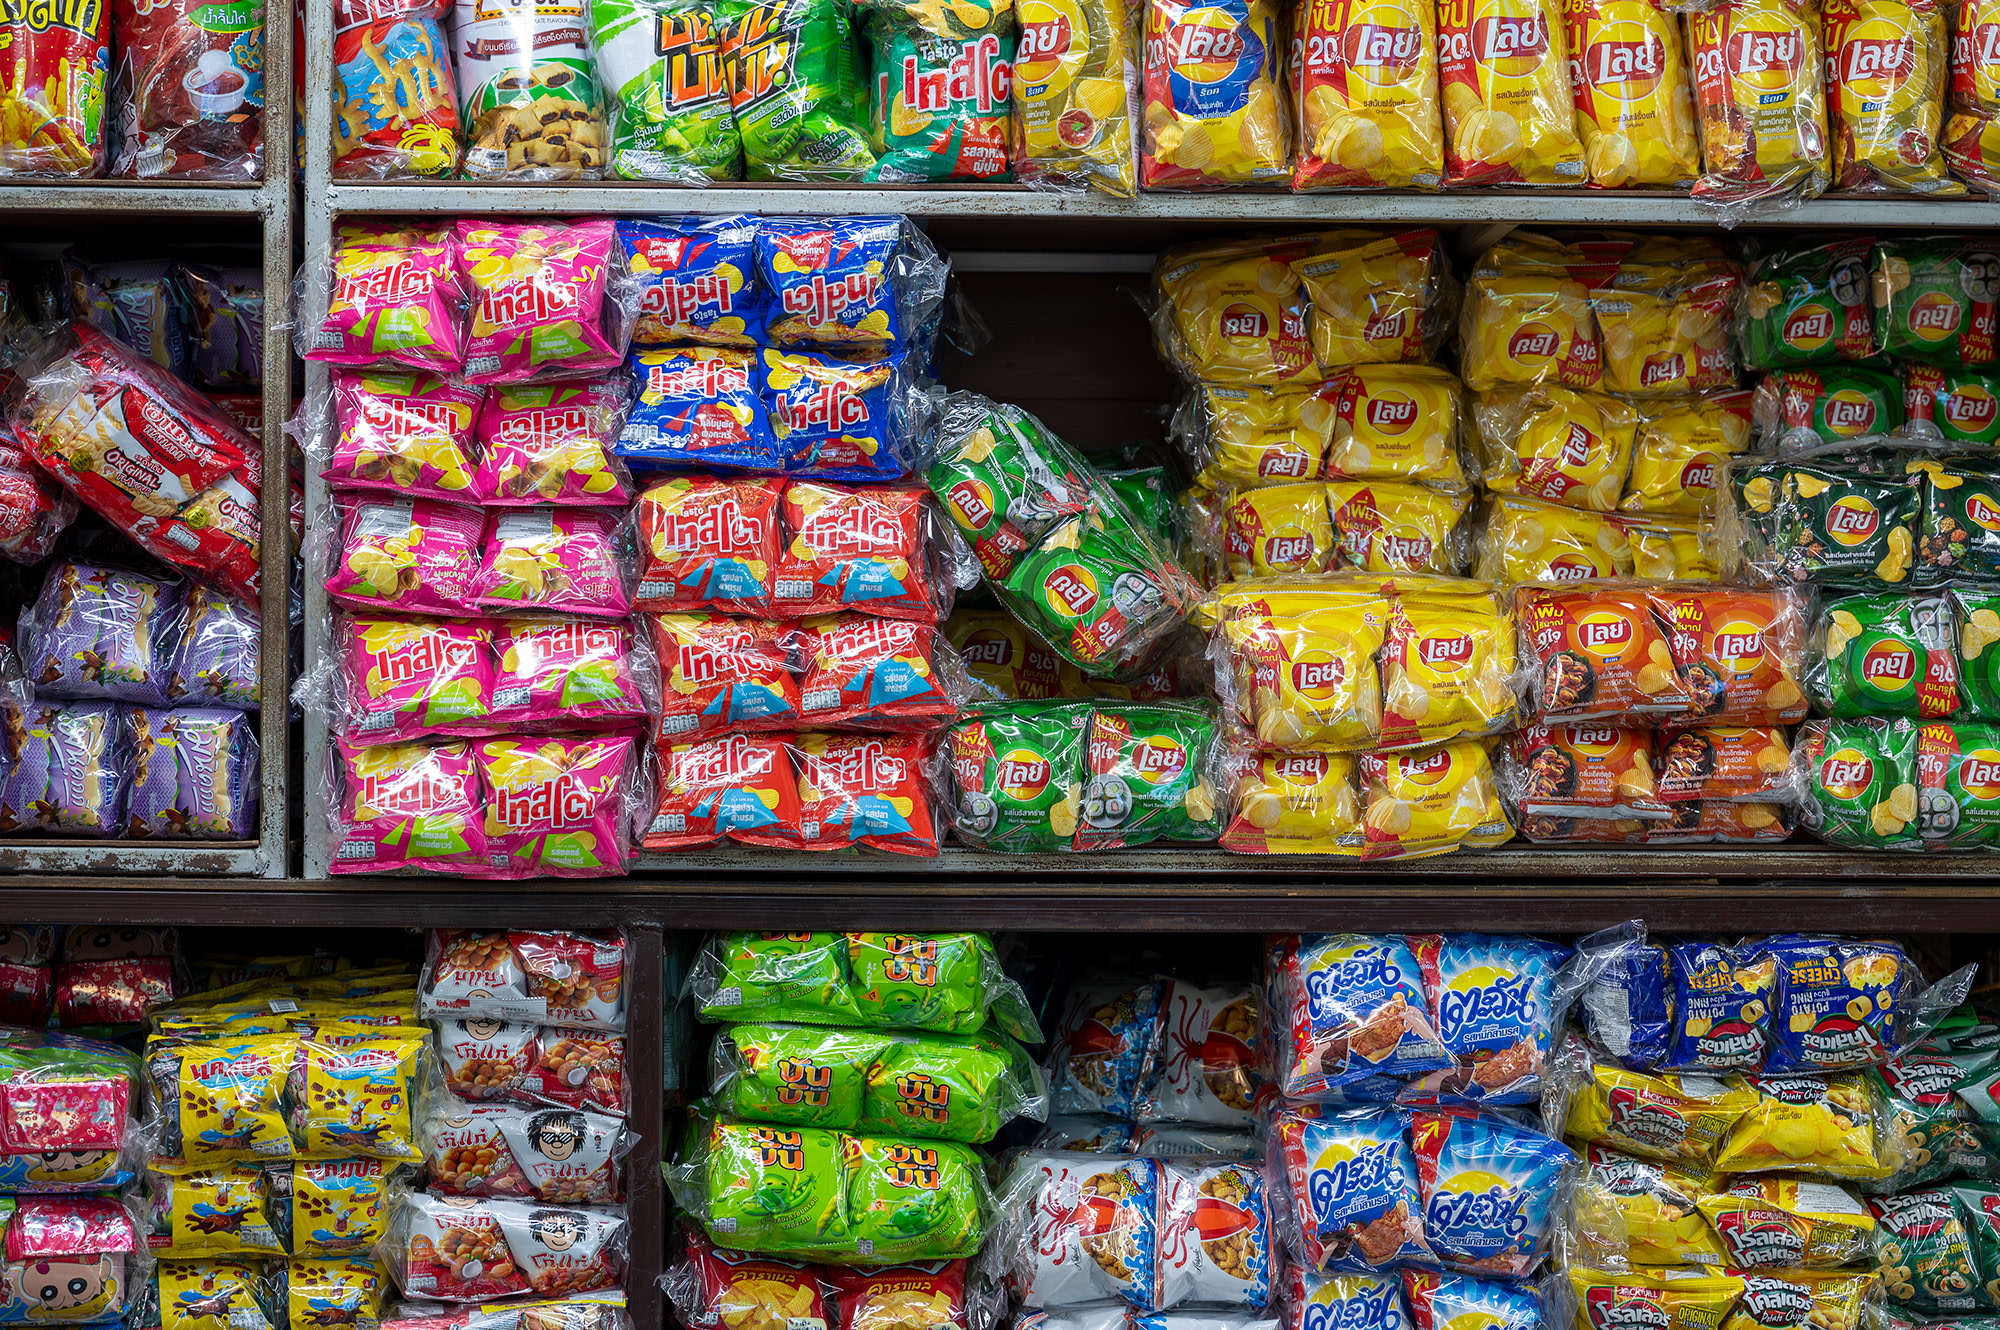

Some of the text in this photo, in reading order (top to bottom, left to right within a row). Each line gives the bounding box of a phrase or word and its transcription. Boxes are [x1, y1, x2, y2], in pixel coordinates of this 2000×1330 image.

[203, 10, 247, 26] น้ำจิ้มไก่
[920, 43, 956, 61] Tasto
[1308, 34, 1341, 67] 20%
[1353, 24, 1419, 68] เลย์
[1440, 33, 1471, 65] 20%
[1486, 17, 1544, 66] เลย์
[1739, 26, 1799, 75] เลย์
[1596, 36, 1658, 85] เลย์
[1848, 35, 1908, 81] เลย์
[1310, 66, 1336, 76] ราคาเดิม
[1364, 97, 1408, 111] รสมันฝรั่งแท้
[1497, 86, 1541, 103] รสมันฝรั่งแท้
[973, 156, 999, 174] ญี่ปุ่น
[337, 258, 433, 304] เทสโต
[483, 266, 578, 326] เทสโต
[642, 277, 732, 328] เทสโต
[783, 274, 882, 328] เทสโต
[842, 307, 868, 320] Tasto
[1914, 305, 1954, 328] เลย์
[1226, 315, 1260, 338] เลย์
[1790, 316, 1829, 341] เลย์
[1516, 334, 1554, 357] เลย์
[649, 358, 750, 398] เทสโต
[665, 360, 691, 371] Tasto
[1646, 358, 1679, 384] เลย์
[776, 382, 870, 434] เทสโต
[1374, 400, 1414, 422] เลย์
[104, 446, 162, 492] ORIGINAL
[1265, 453, 1301, 477] เลย์
[116, 471, 150, 498] FLAVOUR
[679, 507, 705, 518] Tasto
[1832, 507, 1873, 534] เลย์
[666, 501, 763, 553] เทสโต
[804, 503, 902, 553] เทสโต
[1273, 538, 1312, 563] เลย์
[1391, 539, 1428, 558] เลย์
[1675, 601, 1704, 622] เพิ่ม
[821, 617, 919, 660] เทสโต
[1587, 622, 1626, 647] เลย์
[375, 629, 478, 684] เทสโต
[680, 633, 775, 681] เทสโต
[1429, 636, 1467, 661] เลย์
[1302, 659, 1340, 691] เลย์
[1871, 653, 1909, 677] เลย์
[884, 674, 909, 685] รสปลา
[674, 736, 773, 787] เทสโต
[822, 747, 848, 759] Tasto
[1141, 745, 1182, 774] เลย์
[1284, 754, 1321, 777] เลย์
[183, 731, 226, 818] มินิคุกกี้
[806, 741, 906, 792] เทสโต
[1004, 761, 1046, 788] เลย์
[1828, 762, 1867, 786] เลย์
[513, 780, 539, 792] Tasto
[1139, 792, 1182, 802] รสโนริสาหร่าย
[1415, 792, 1452, 804] รสมันฝรั่งแท้
[496, 773, 597, 829] เทสโต
[1004, 808, 1046, 819] รสโนริสาหร่าย
[864, 811, 889, 821] รสปลา
[886, 935, 939, 960] บัน
[454, 967, 505, 989] โก๋แก่
[883, 956, 938, 988] บัน
[1306, 945, 1401, 1021] ตะวัน
[1791, 966, 1842, 985] CHEESE
[1439, 977, 1539, 1045] ตะวัน
[1688, 995, 1710, 1009] RING
[1789, 991, 1815, 1006] RING
[1790, 1002, 1831, 1017] POTATO
[1688, 1007, 1725, 1020] POTATO
[1463, 1025, 1521, 1043] รสหมึกสามรส
[1801, 1026, 1877, 1051] โคสเตอร์
[453, 1043, 509, 1061] โก๋แก่
[779, 1056, 832, 1087] บัน
[1886, 1061, 1968, 1081] โรลเลอร์
[777, 1083, 831, 1108] บัน
[895, 1073, 950, 1103] บัน
[1757, 1079, 1829, 1095] โคสเตอร์
[1780, 1089, 1824, 1103] Potato Chips
[1618, 1101, 1690, 1132] โรลเลอร์
[436, 1127, 488, 1150] โก๋แก่
[755, 1142, 805, 1171] บัน
[884, 1143, 938, 1167] บัน
[532, 1160, 588, 1178] โก๋แก่
[886, 1161, 940, 1191] บัน
[1309, 1141, 1404, 1222] ตะวัน
[1334, 1194, 1390, 1220] รสหมึกสามรส
[1428, 1186, 1529, 1241] ตะวัน
[1882, 1192, 1954, 1213] โรลเลอร์
[1890, 1204, 1957, 1234] โคสเตอร์
[1447, 1234, 1505, 1248] รสหมึกสามรส
[1727, 1225, 1806, 1250] โรลเลอร์
[1731, 1245, 1806, 1269] โคสเตอร์
[734, 1270, 798, 1287] คาราเมล
[867, 1281, 932, 1297] คาราเมล
[1592, 1301, 1671, 1326] โรลเลอร์
[1745, 1291, 1815, 1311] โคสเตอร์
[1679, 1304, 1716, 1324] ORIGINAL
[1762, 1310, 1808, 1325] Potato Chips
